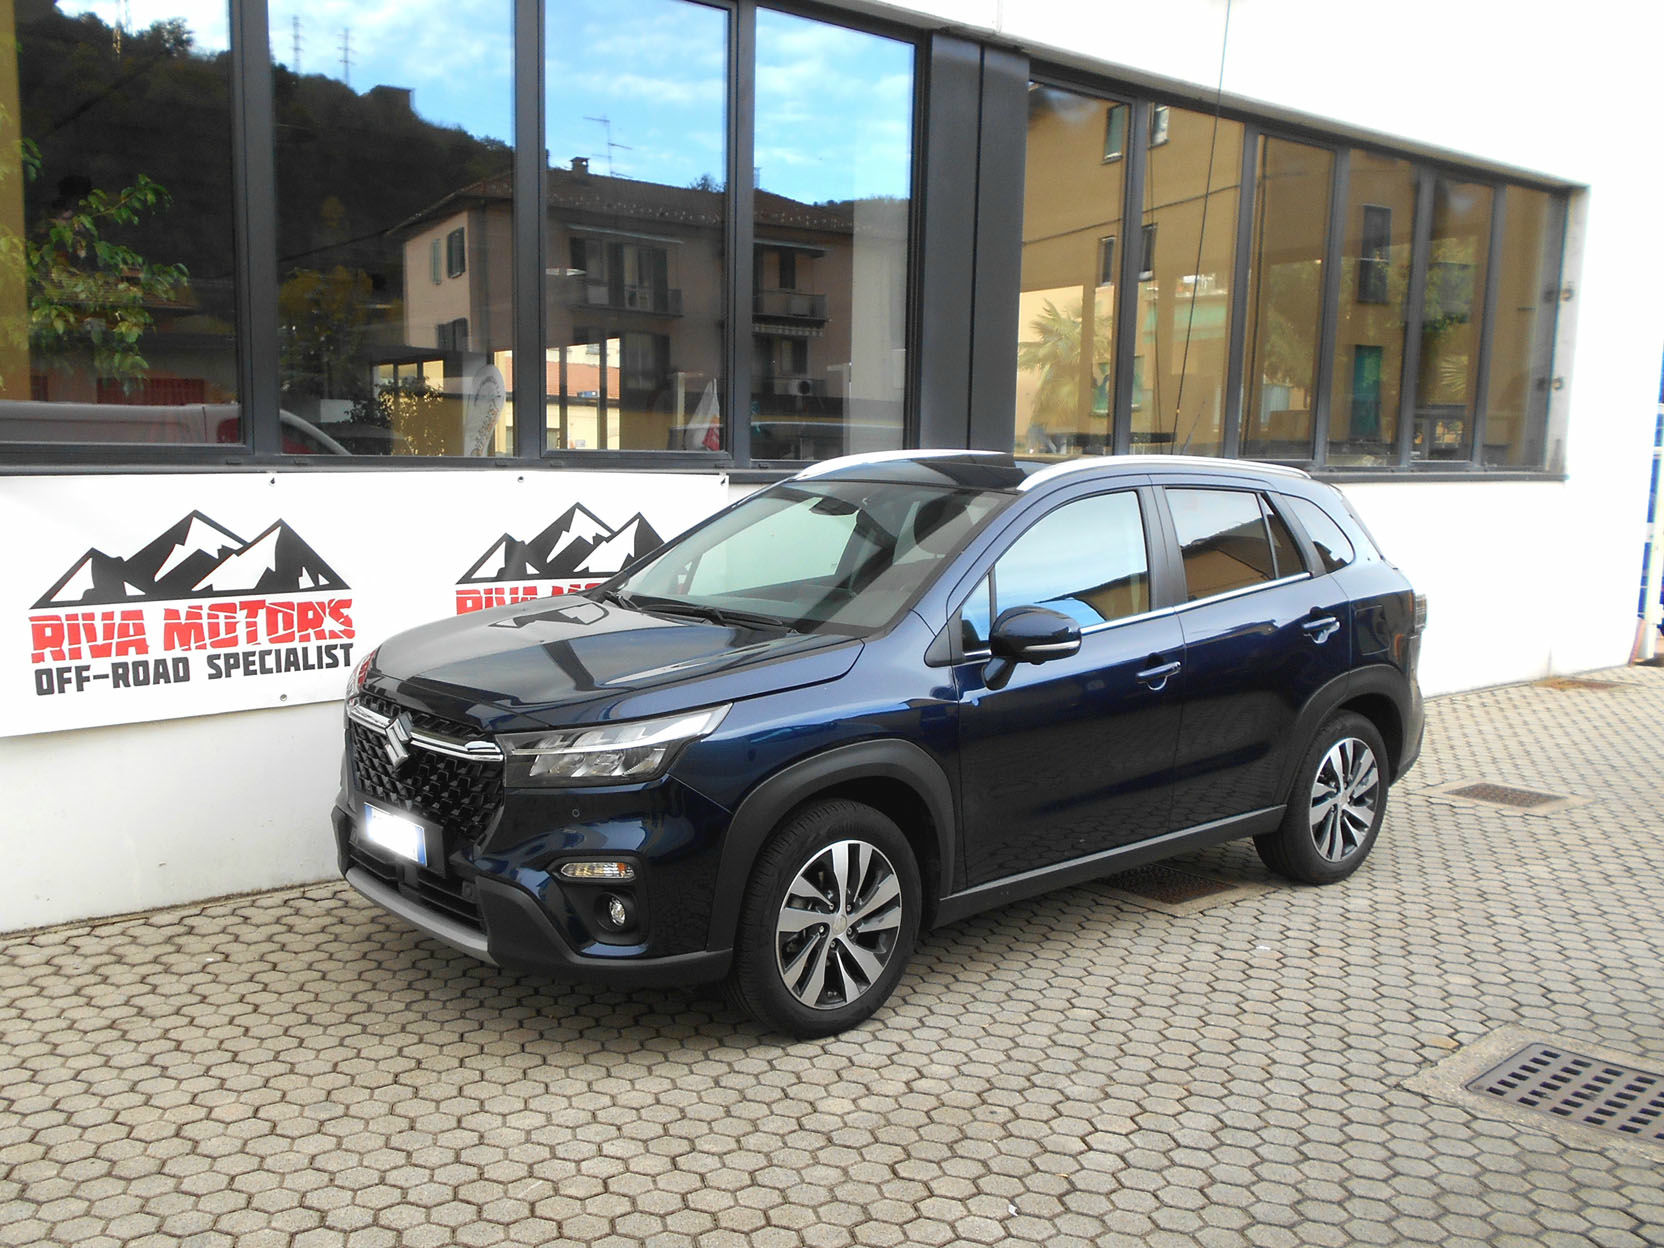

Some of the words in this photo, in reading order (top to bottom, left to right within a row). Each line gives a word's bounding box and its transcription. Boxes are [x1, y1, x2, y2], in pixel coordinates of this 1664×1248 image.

[29, 609, 150, 664] RIVA
[163, 598, 356, 652] MOTORS
[34, 656, 191, 696] OFF-ROAD
[206, 642, 354, 680] SPECIALIST
